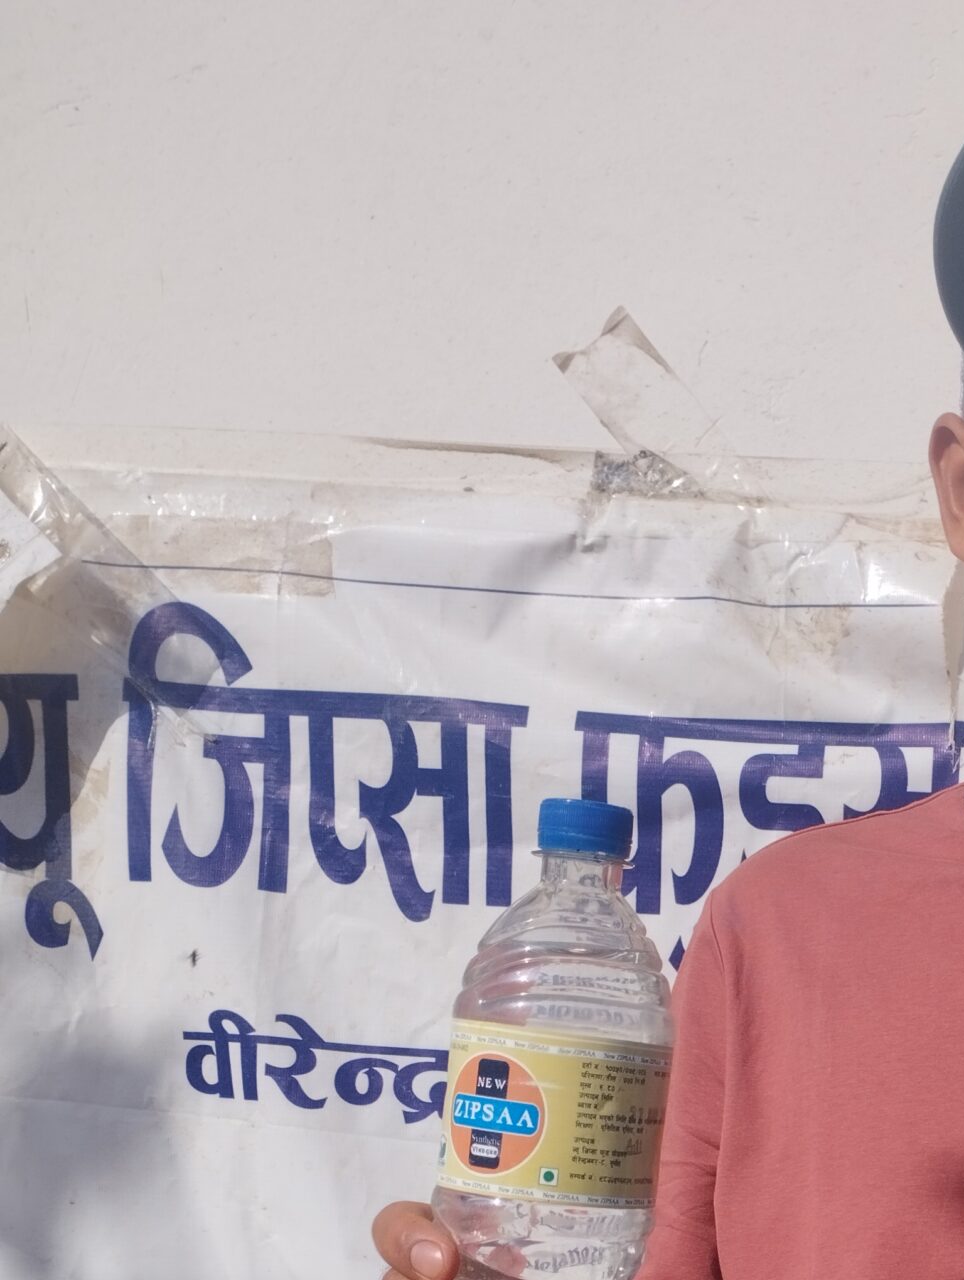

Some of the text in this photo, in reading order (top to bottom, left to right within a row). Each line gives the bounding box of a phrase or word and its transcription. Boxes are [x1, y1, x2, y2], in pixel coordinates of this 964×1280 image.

[122, 601, 530, 923] जिप्सा
[477, 1075, 506, 1090] NEW
[454, 1098, 535, 1129] ZIPSAA
